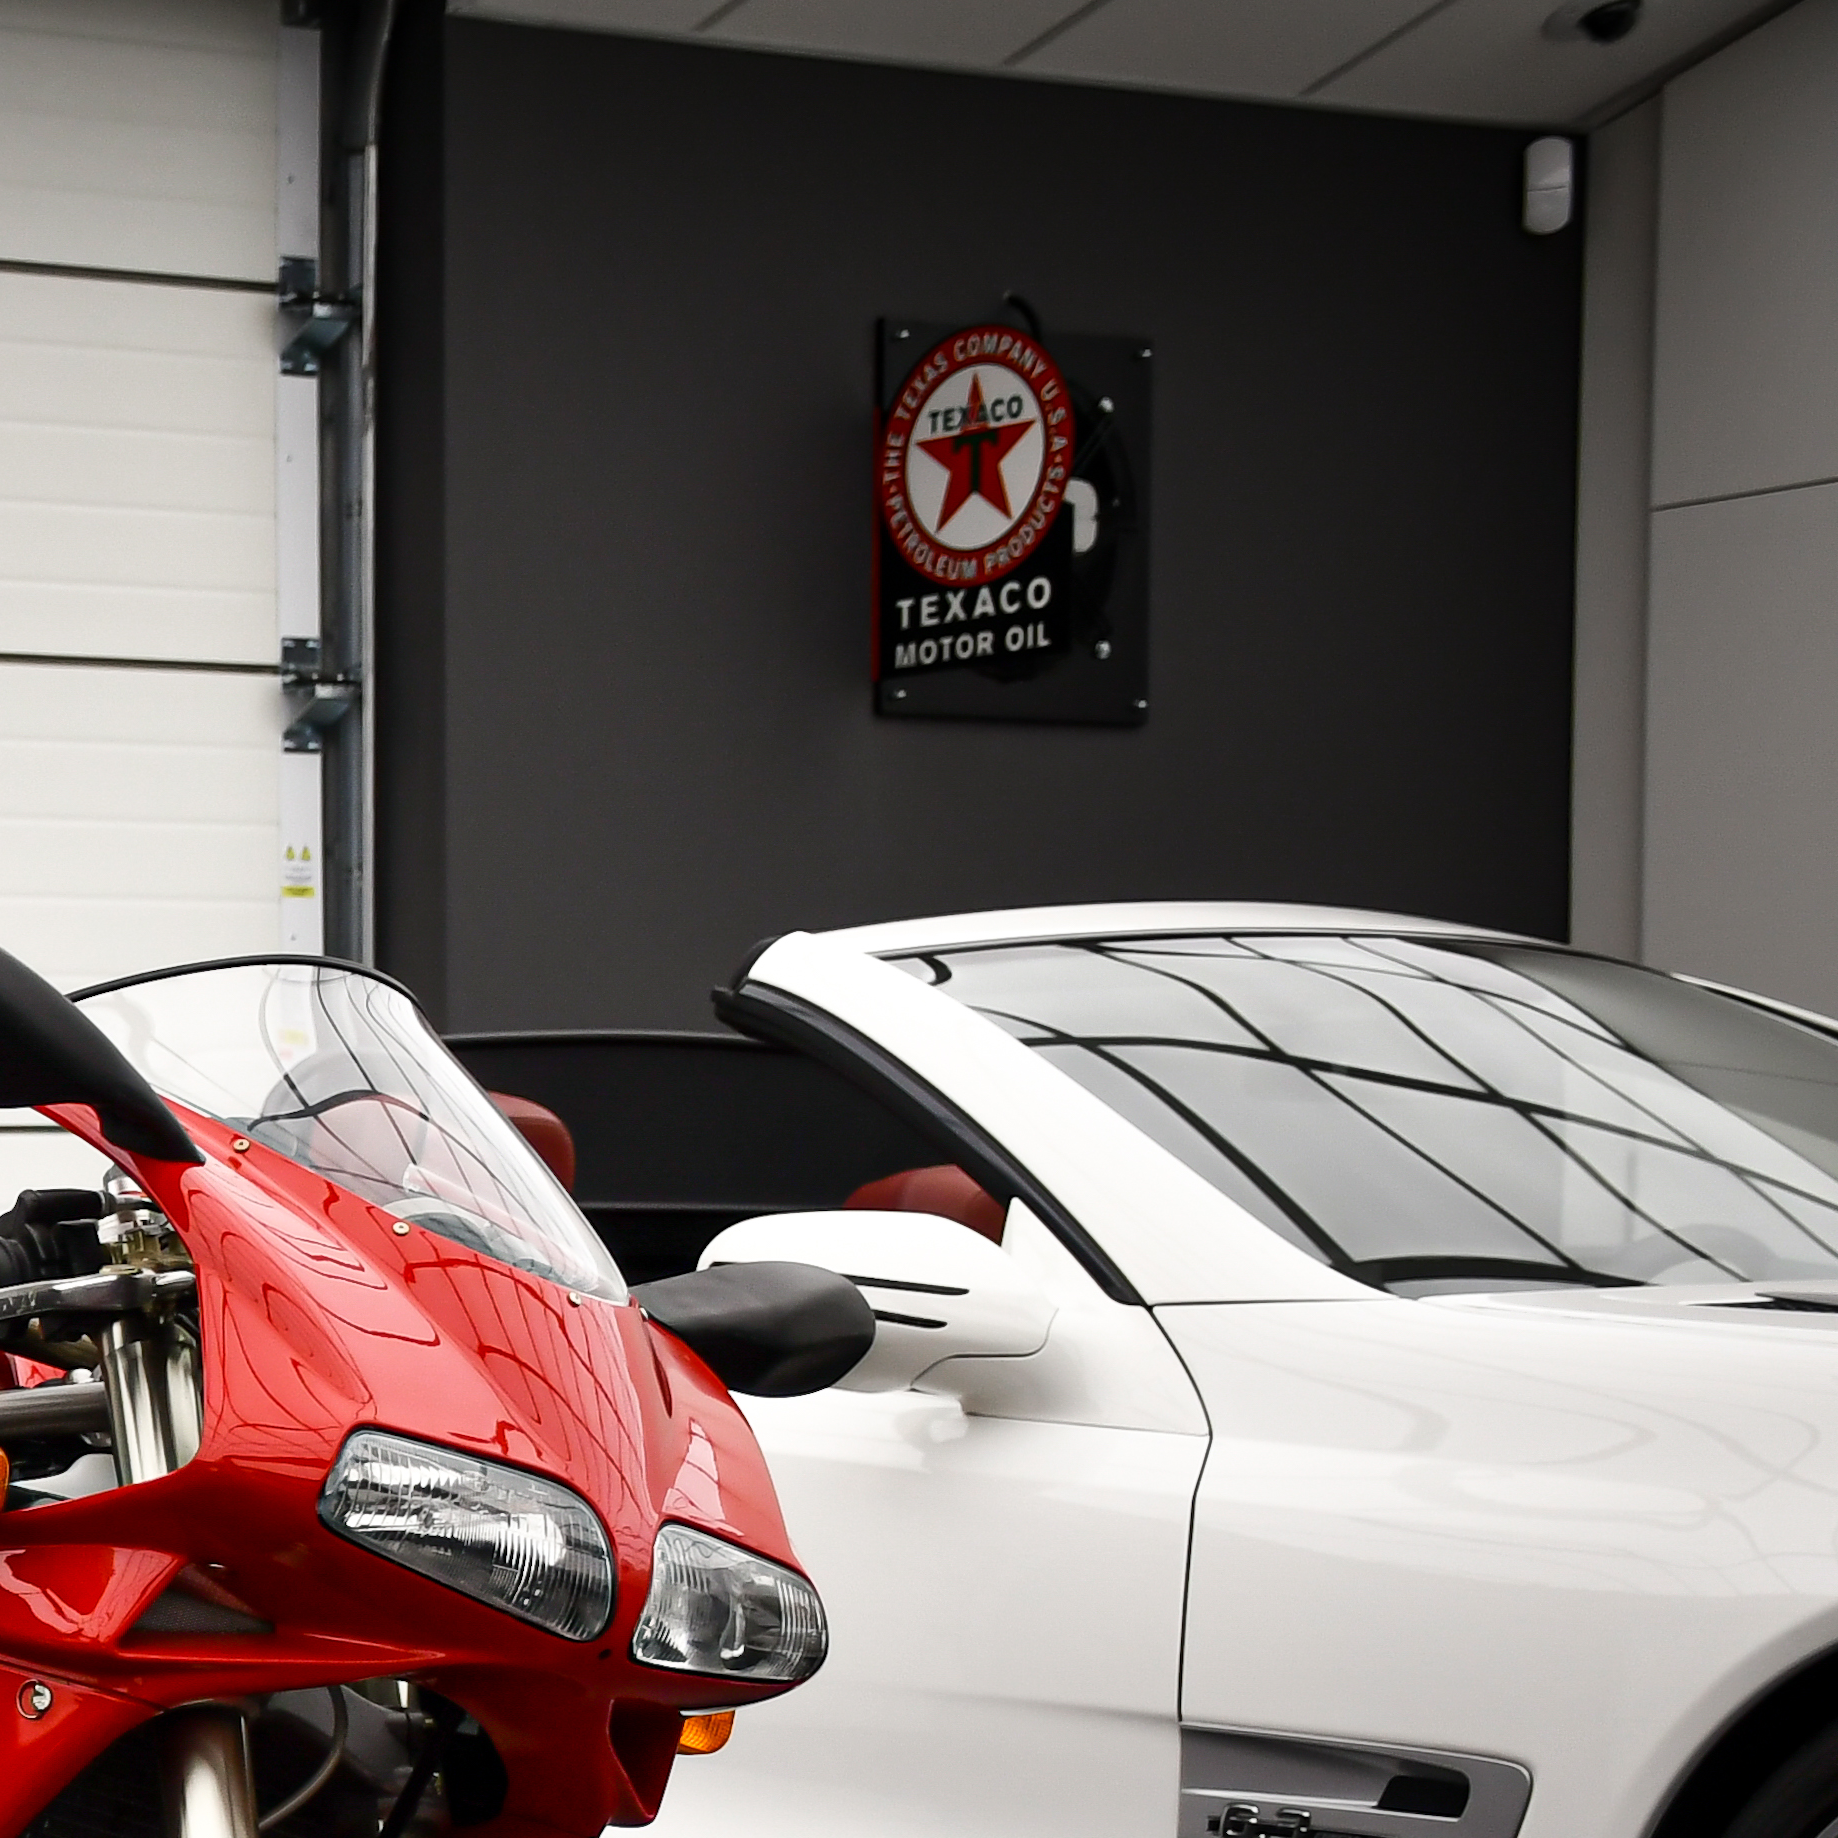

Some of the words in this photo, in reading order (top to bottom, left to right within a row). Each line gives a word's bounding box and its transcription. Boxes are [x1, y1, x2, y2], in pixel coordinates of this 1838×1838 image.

[883, 432, 905, 484] THE
[895, 351, 949, 420] TEXAS
[953, 333, 1047, 379] COMPANY
[886, 494, 978, 581] PETROLEUM
[983, 465, 1066, 576] PRODUCTS
[894, 629, 995, 669] MOTOR
[1005, 620, 1052, 652] OIL
[895, 575, 1052, 630] TEXACO
